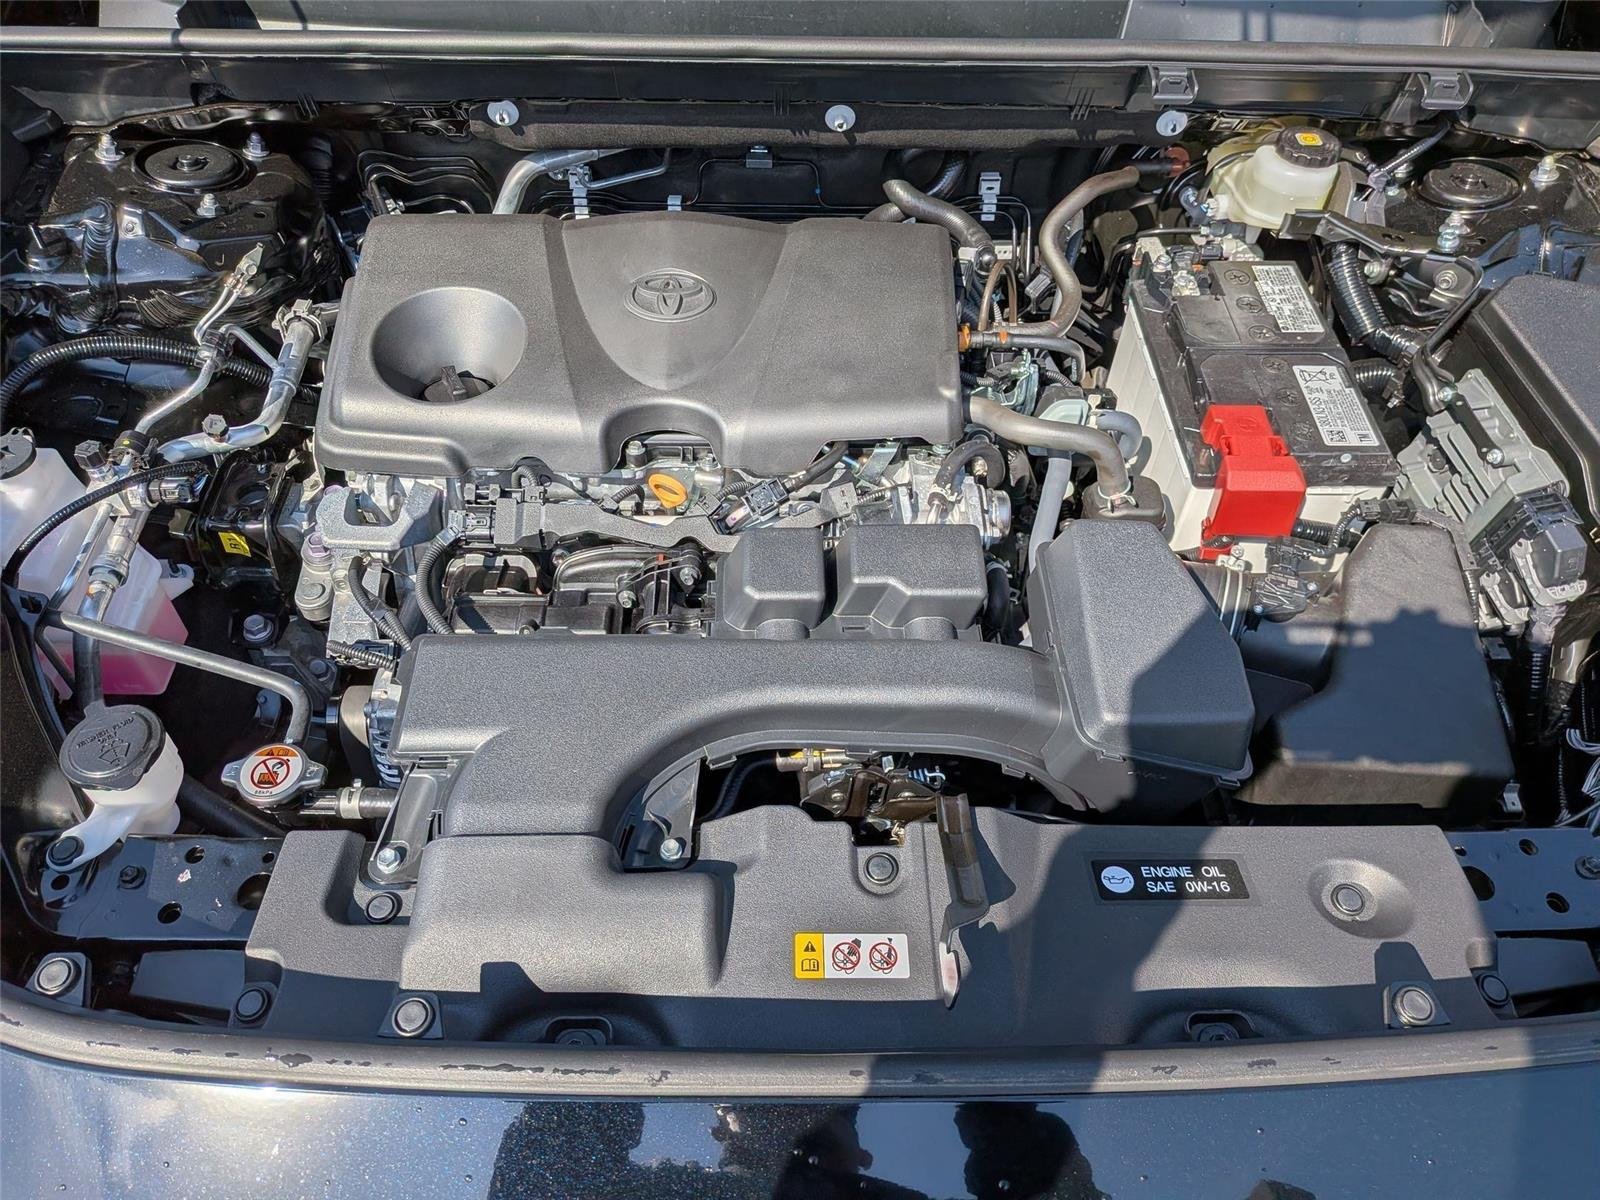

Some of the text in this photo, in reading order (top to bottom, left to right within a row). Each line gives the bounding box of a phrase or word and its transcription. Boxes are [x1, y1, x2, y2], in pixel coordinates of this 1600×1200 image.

[1140, 866, 1226, 878] ENGINE OIL
[1147, 881, 1231, 893] SAE 0W-16
